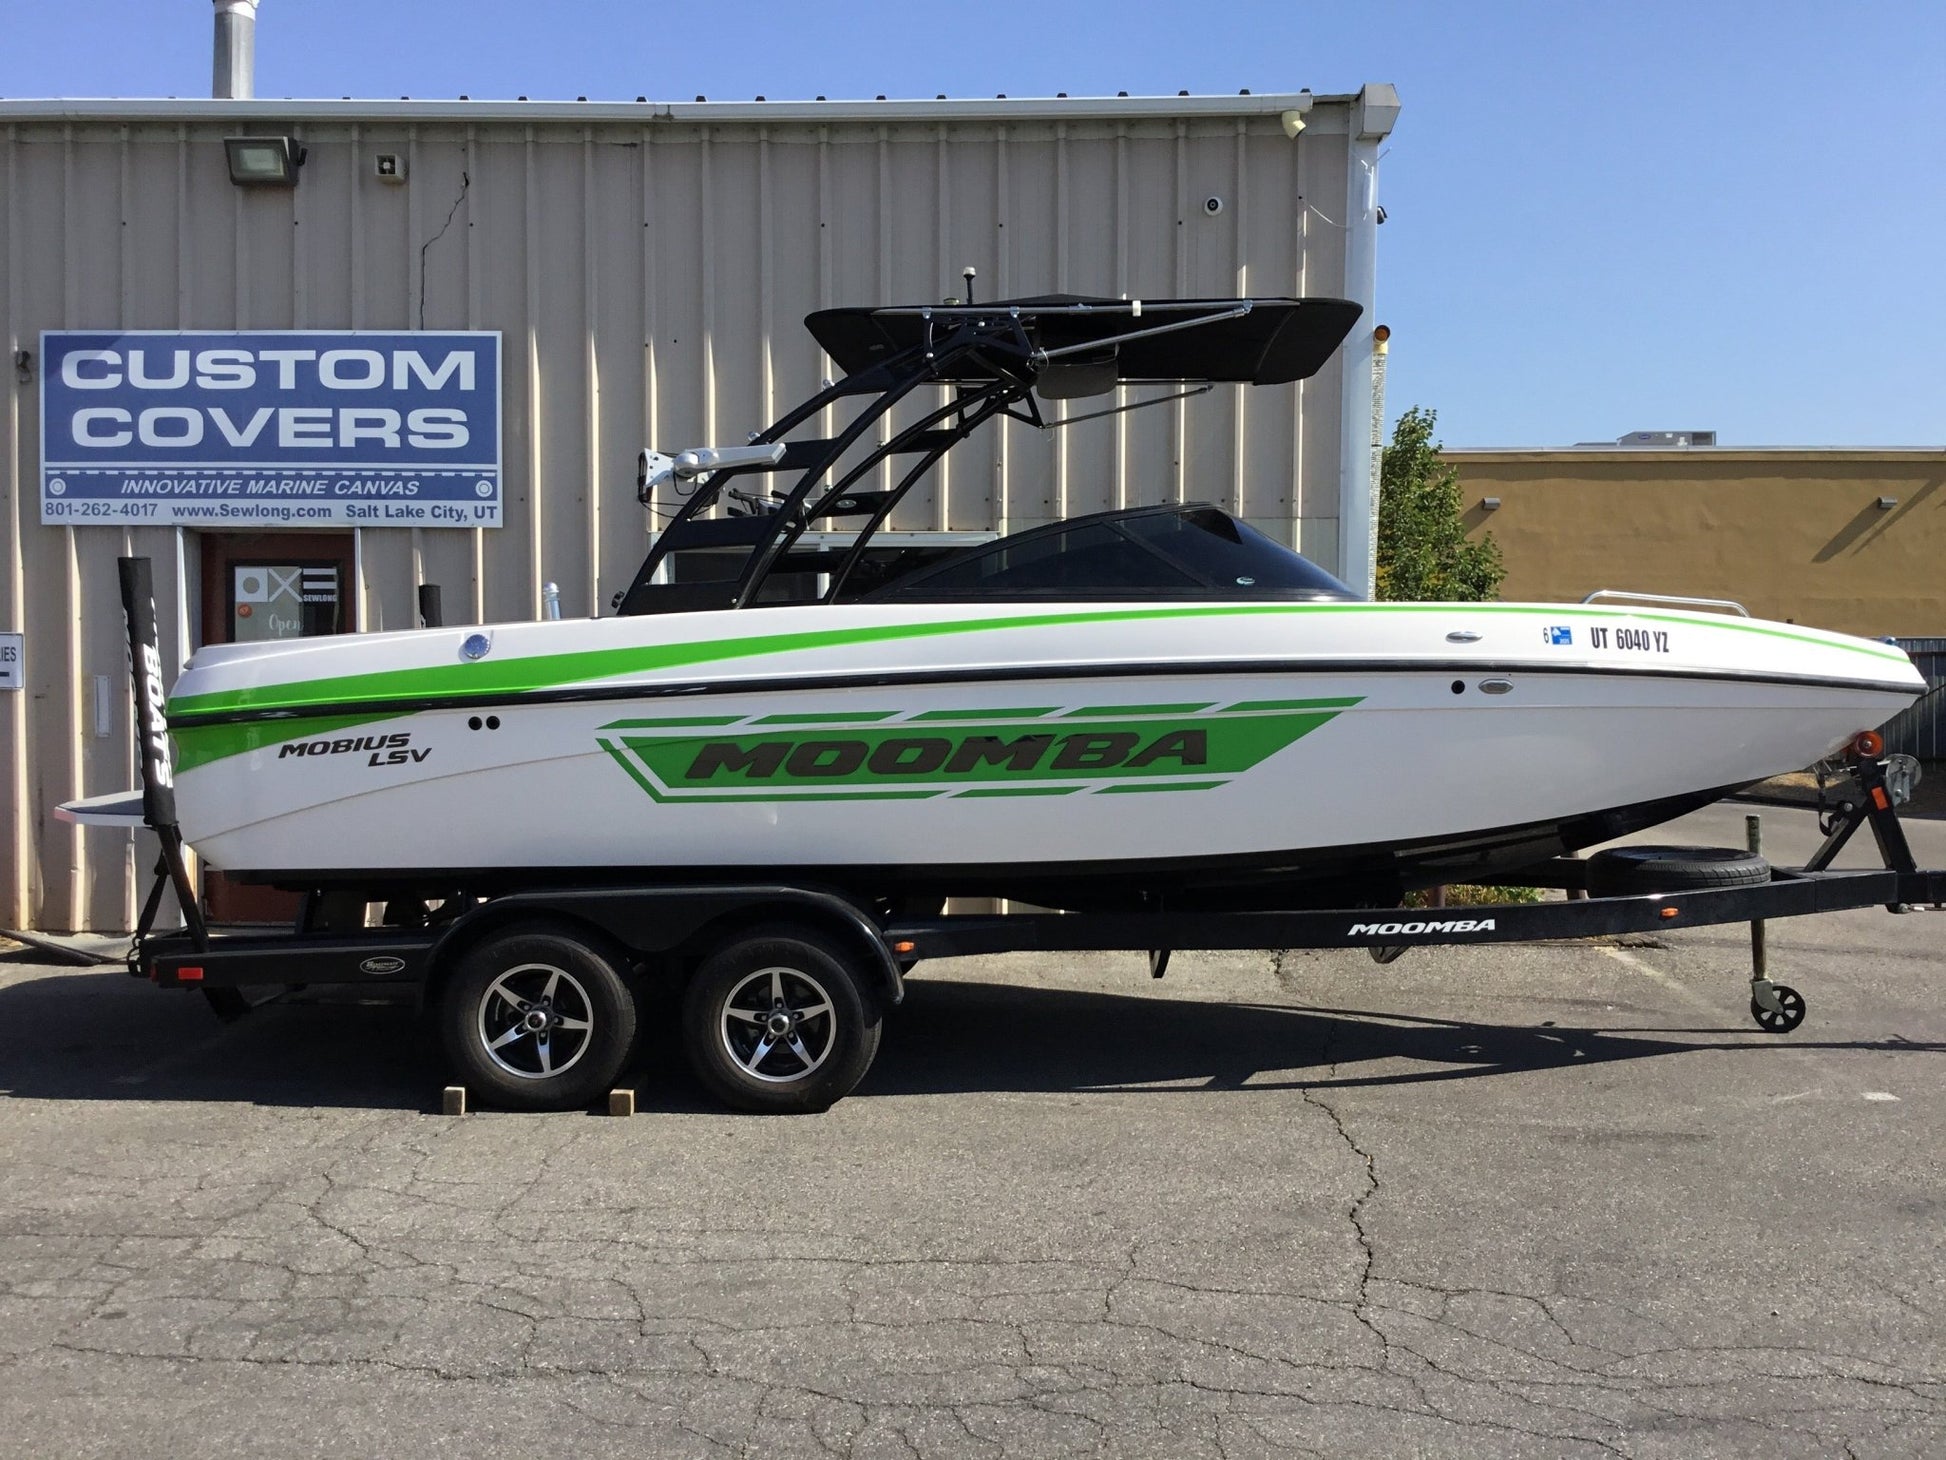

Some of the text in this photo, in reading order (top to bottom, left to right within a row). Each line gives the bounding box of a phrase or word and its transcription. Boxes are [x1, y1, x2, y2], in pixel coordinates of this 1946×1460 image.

[61, 350, 476, 391] CUSTOM
[71, 407, 470, 449] COVERS
[121, 480, 420, 495] INNOVATIVE MARINE CANVAS
[45, 503, 497, 522] 801-262-4017 www.Sewlong.com Salt Lake City, UT
[303, 594, 337, 602] SEWLONG
[1543, 627, 1550, 644] 6
[1590, 627, 1670, 653] UT 6040 YZ
[143, 643, 173, 788] BOATS
[278, 733, 411, 759] MOBIUS
[684, 729, 1208, 779] MOOMBA
[368, 748, 432, 767] LSV
[1347, 919, 1496, 936] MOOMBA
